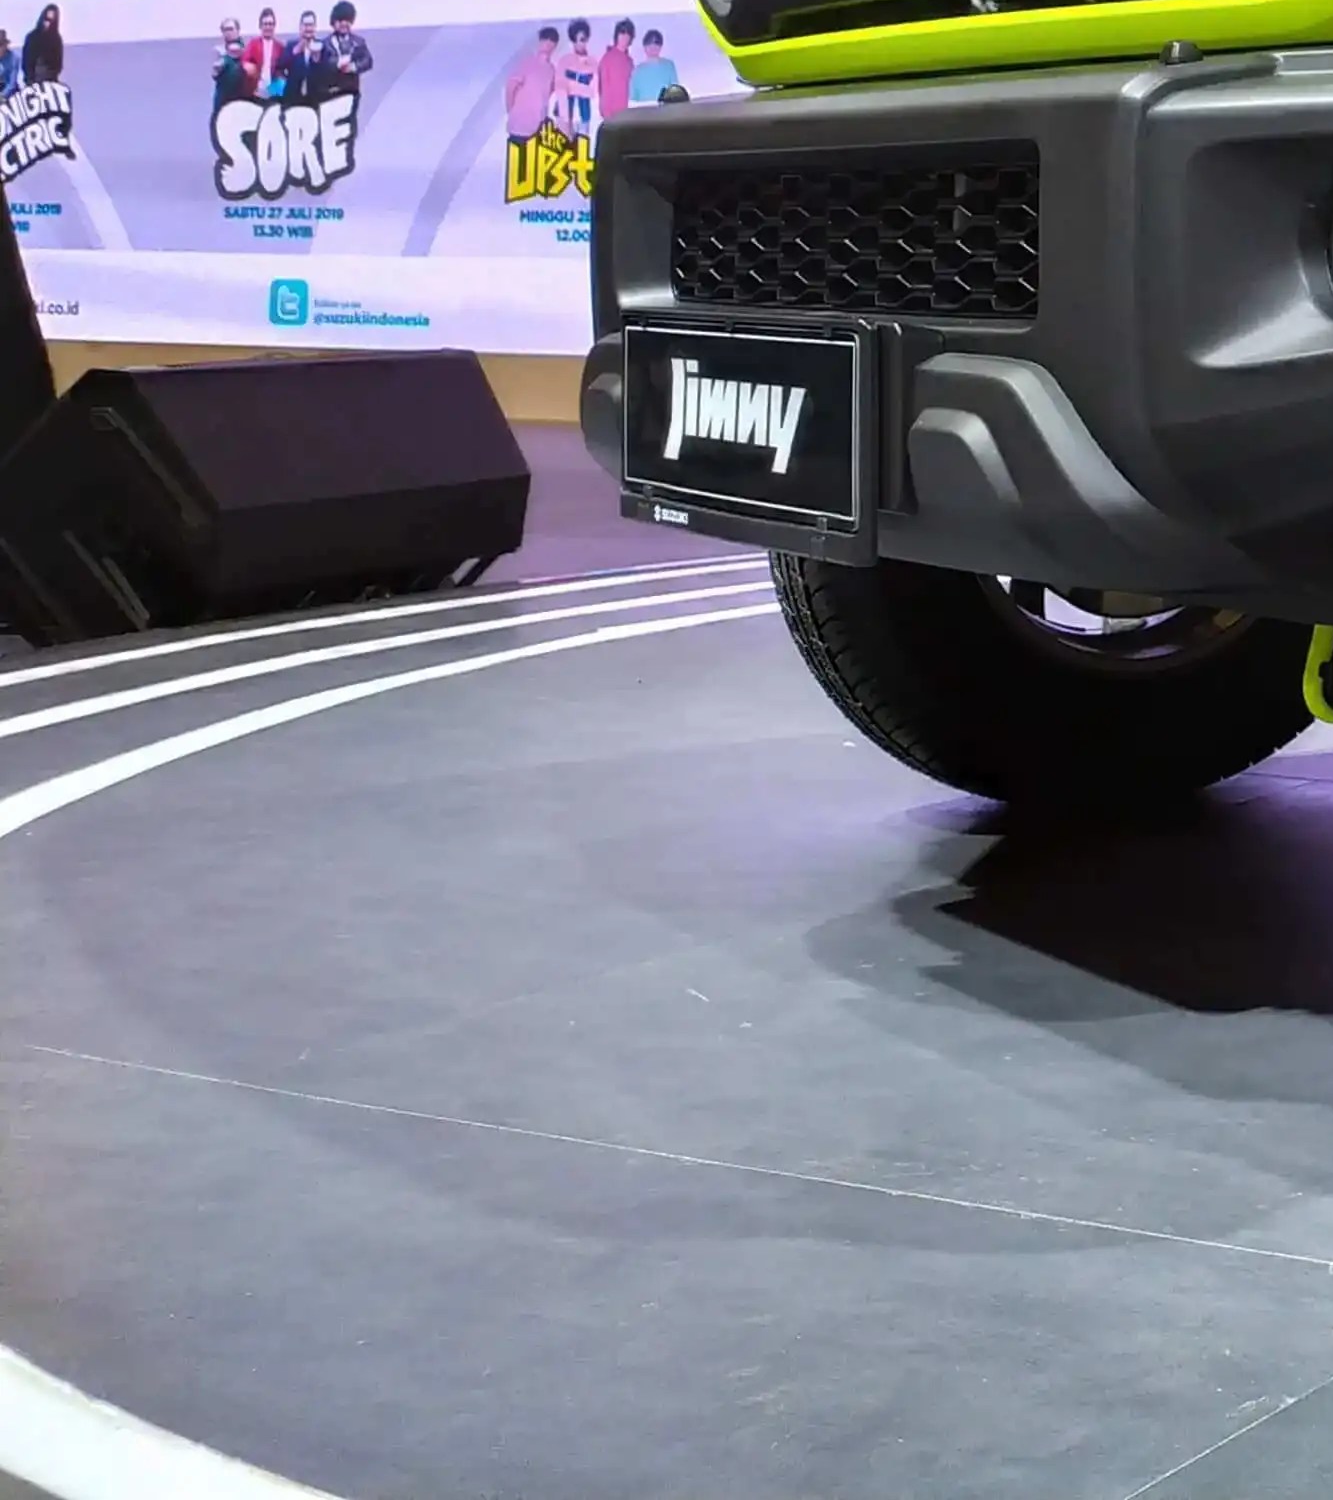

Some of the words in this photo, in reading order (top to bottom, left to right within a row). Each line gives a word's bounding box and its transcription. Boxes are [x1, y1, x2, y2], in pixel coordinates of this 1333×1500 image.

[0, 116, 69, 180] CTRIC
[216, 94, 354, 193] SORE
[540, 120, 567, 151] the
[315, 209, 344, 220] 2019
